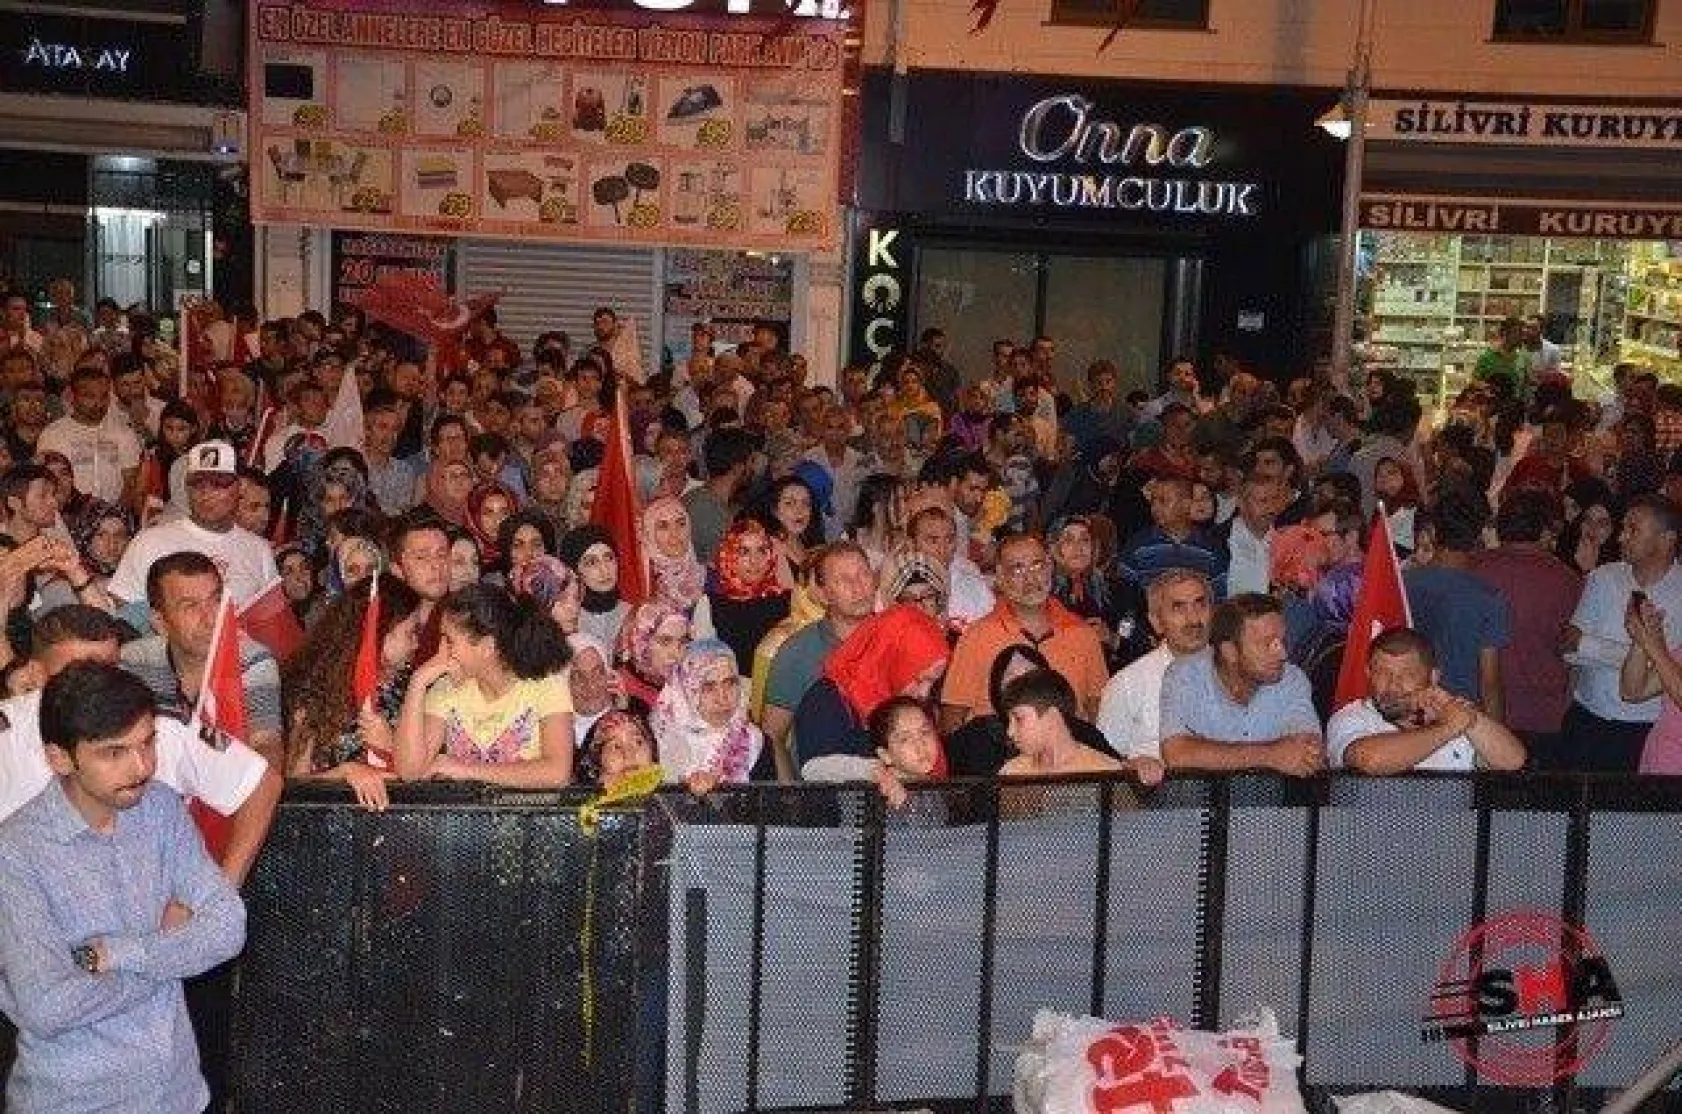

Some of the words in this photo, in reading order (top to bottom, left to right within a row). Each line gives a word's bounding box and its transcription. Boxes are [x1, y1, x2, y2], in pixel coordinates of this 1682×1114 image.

[1020, 94, 1217, 168] Onna
[1395, 102, 1530, 137] SİLİVRİ
[965, 170, 1256, 216] KUYUMCULUK
